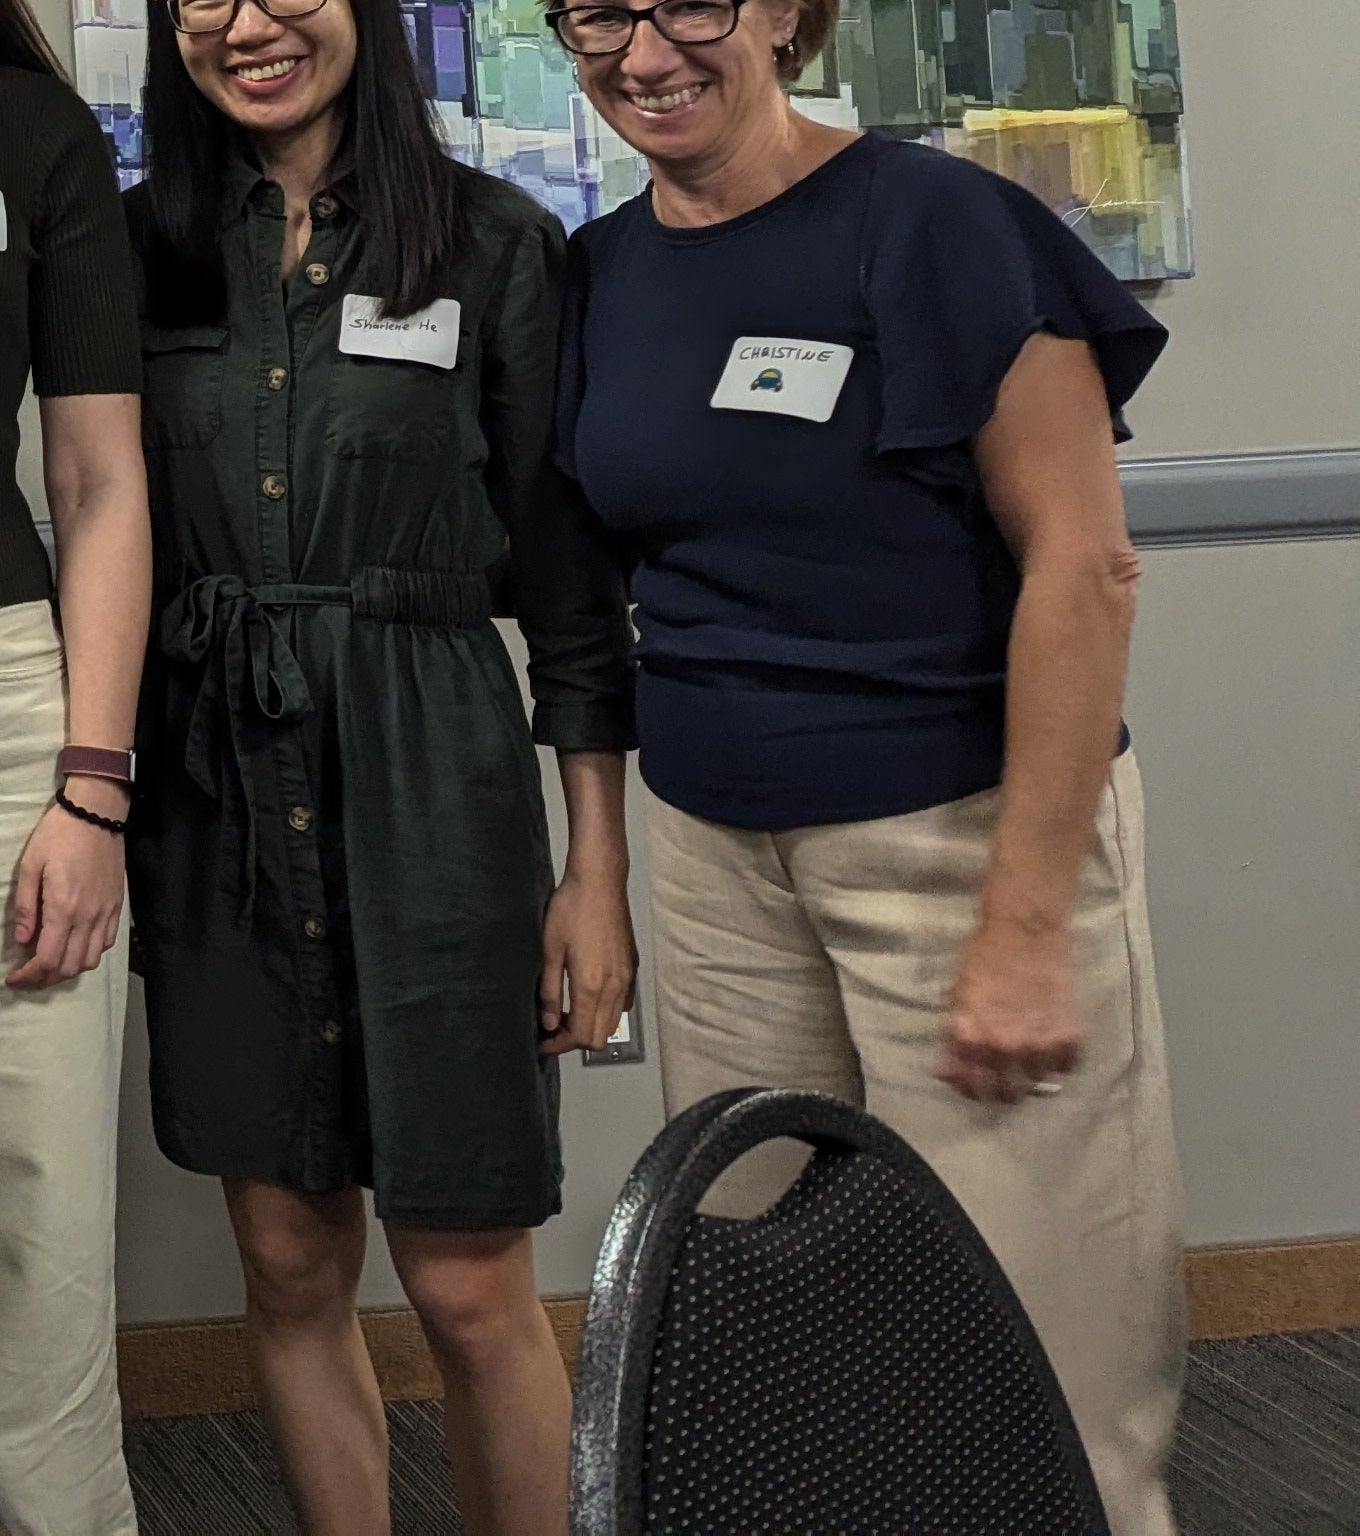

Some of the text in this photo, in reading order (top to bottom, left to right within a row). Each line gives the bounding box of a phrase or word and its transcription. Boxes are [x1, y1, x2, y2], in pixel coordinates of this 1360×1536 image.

[348, 318, 438, 332] Sharlene He
[739, 346, 835, 363] CHRISTINE
